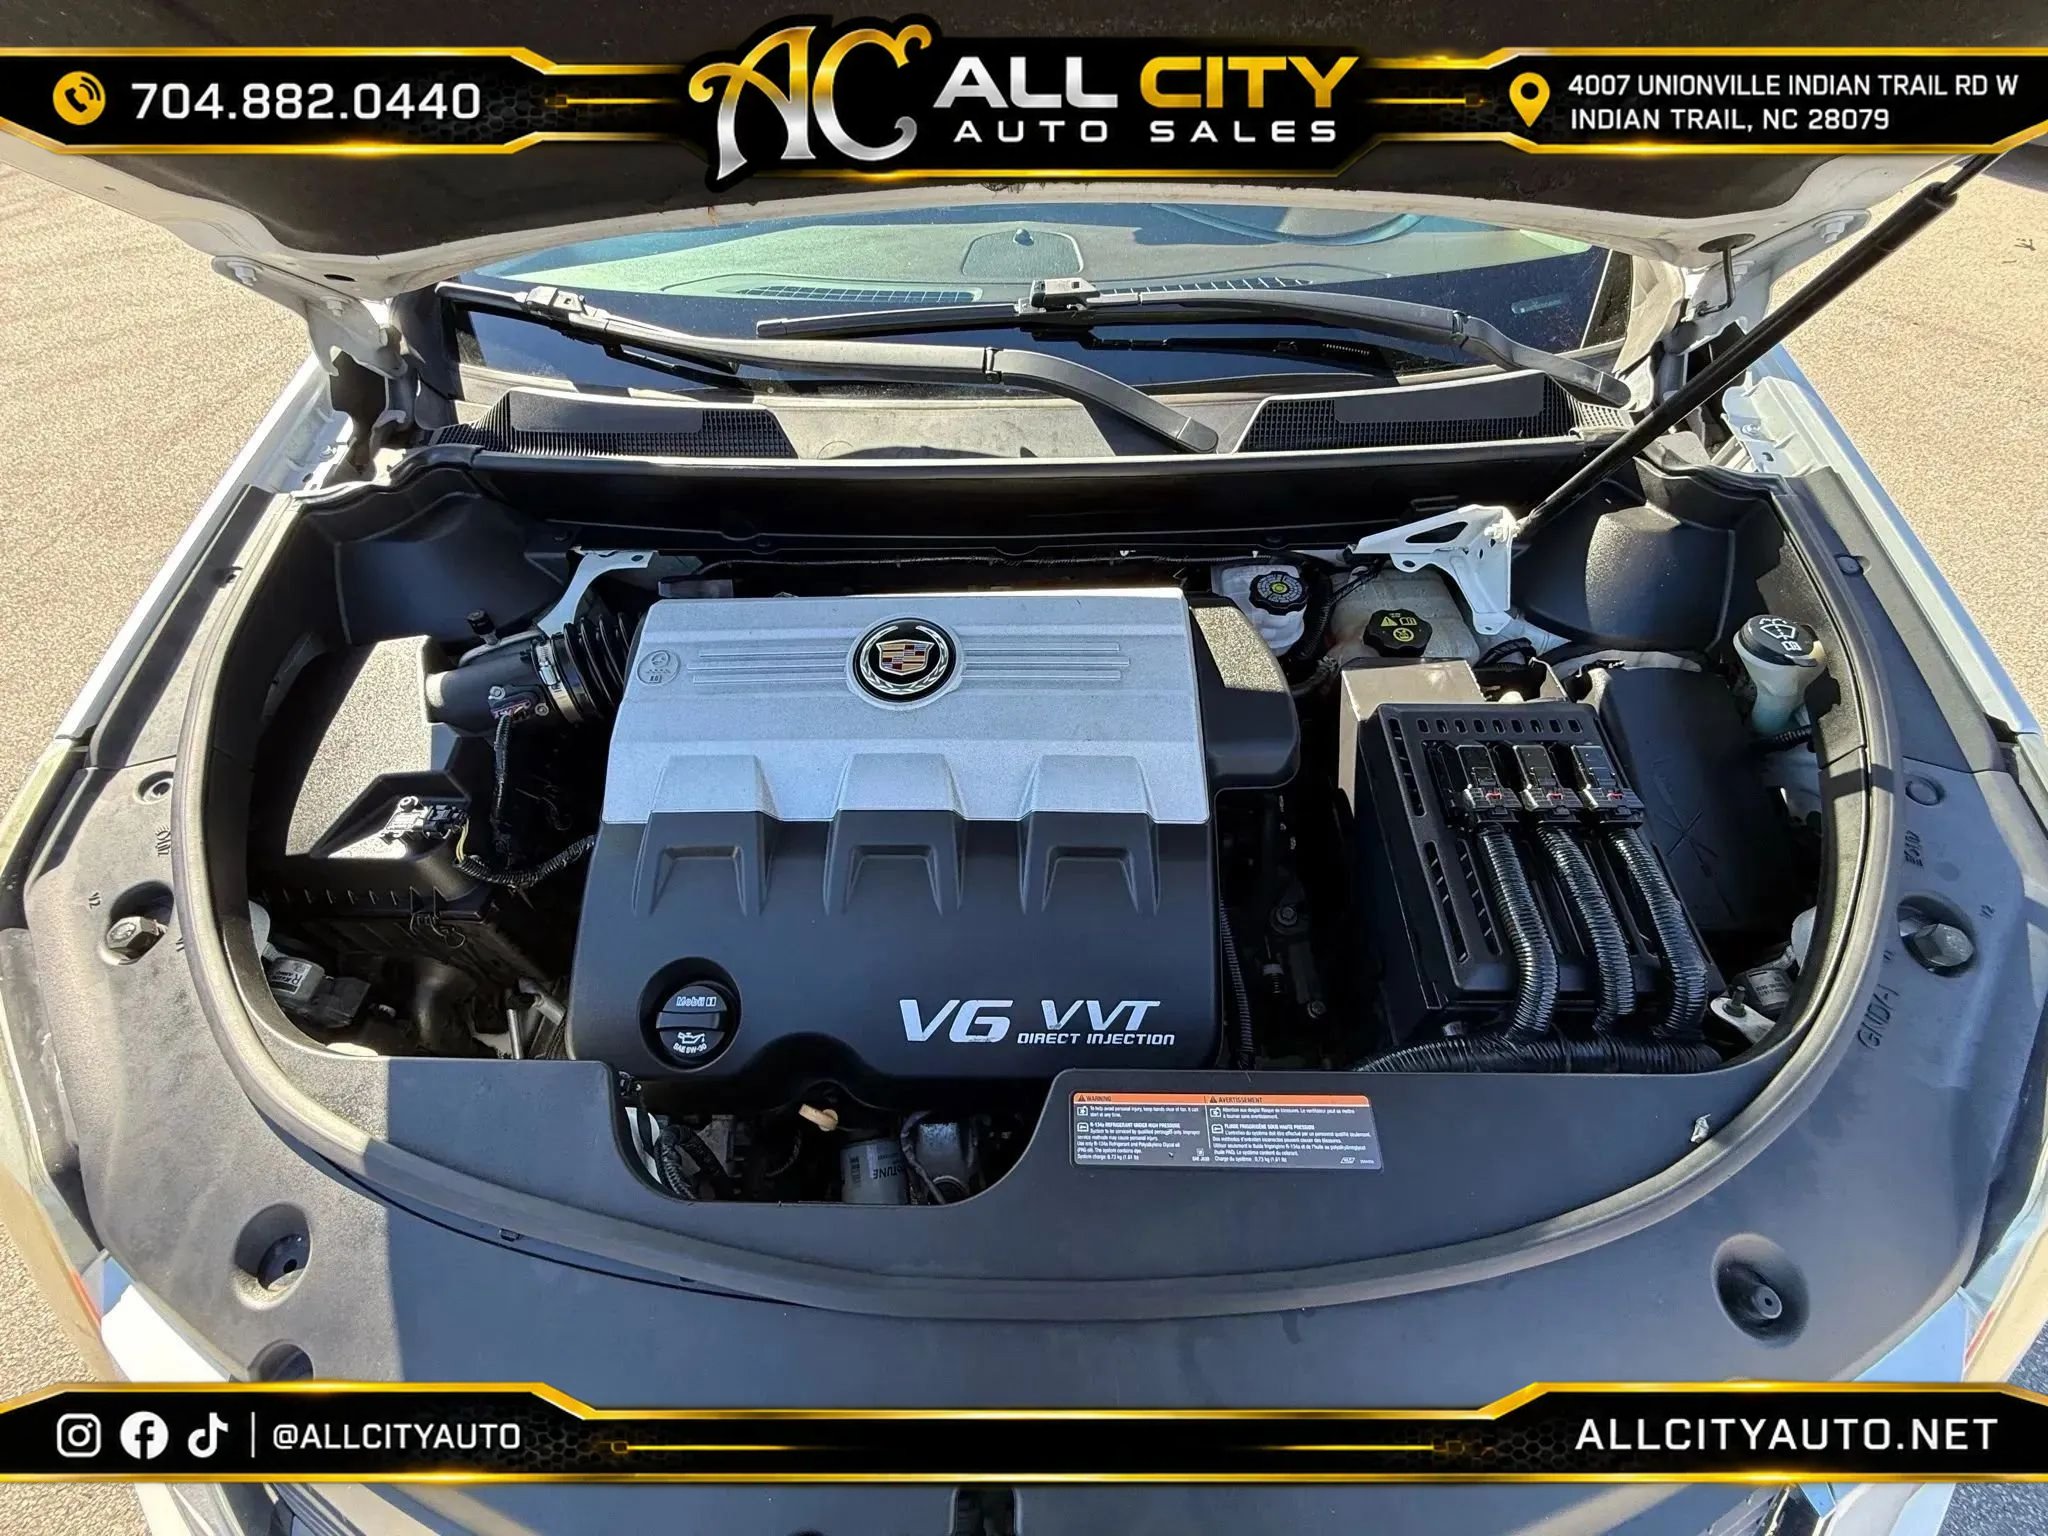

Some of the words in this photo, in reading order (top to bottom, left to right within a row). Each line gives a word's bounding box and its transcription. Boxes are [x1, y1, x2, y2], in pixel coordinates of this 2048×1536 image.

[900, 999, 1013, 1043] V6
[1041, 1000, 1160, 1031] VVT
[1017, 1033, 1080, 1045] DIRECT
[1087, 1033, 1175, 1046] INJECTION
